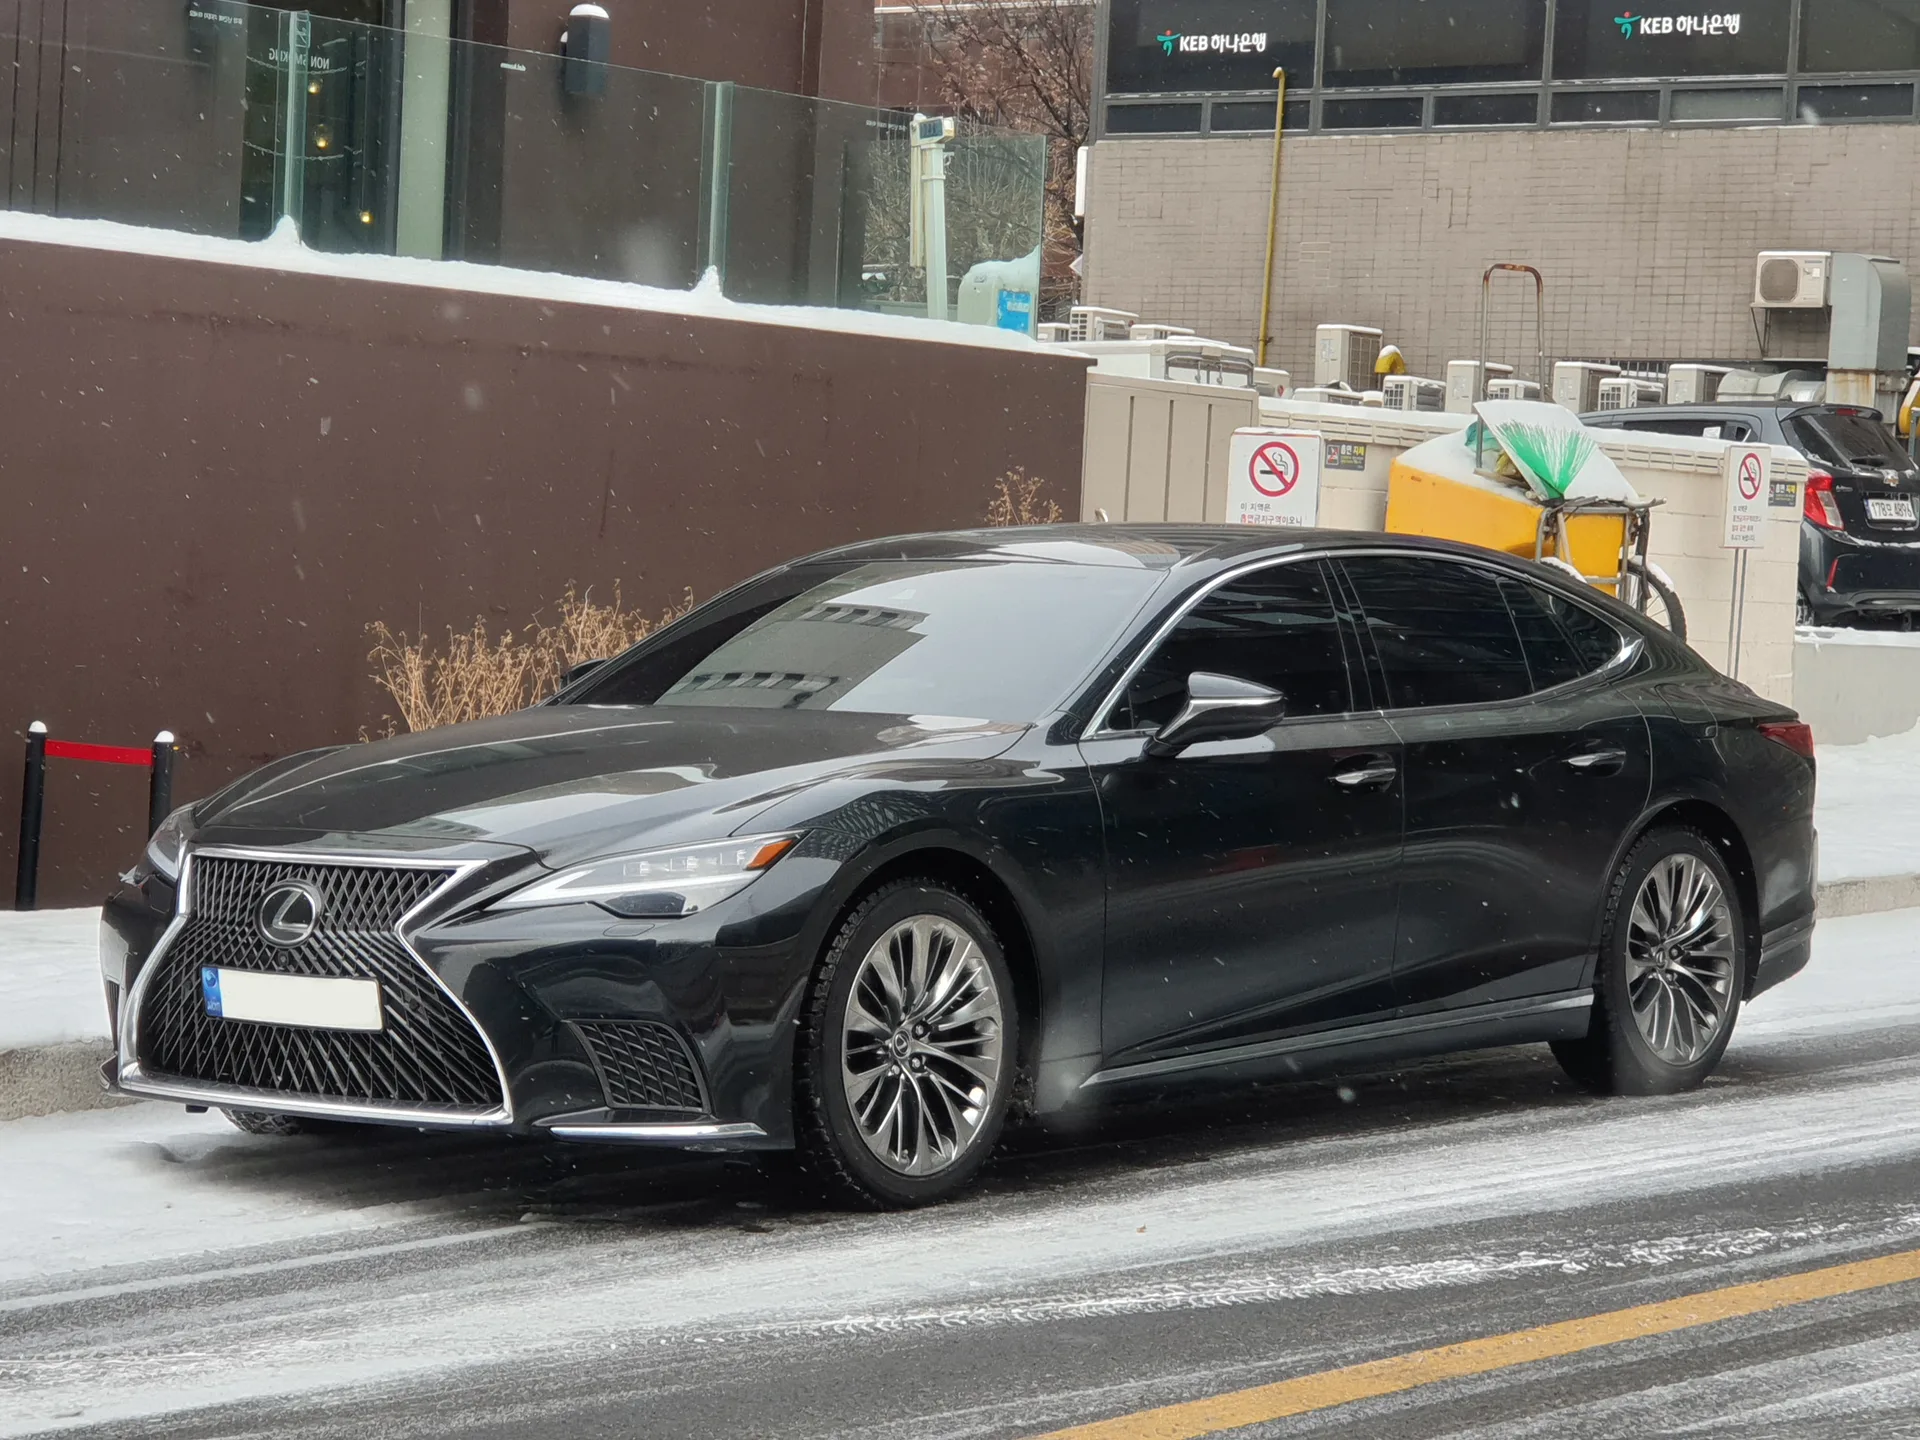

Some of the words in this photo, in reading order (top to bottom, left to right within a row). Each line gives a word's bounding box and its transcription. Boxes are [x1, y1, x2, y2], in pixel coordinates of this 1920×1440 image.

[1640, 16, 1673, 34] KEB
[1675, 13, 1740, 36] 하나은행
[1179, 35, 1208, 52] KEB
[1210, 32, 1267, 54] 하나은행
